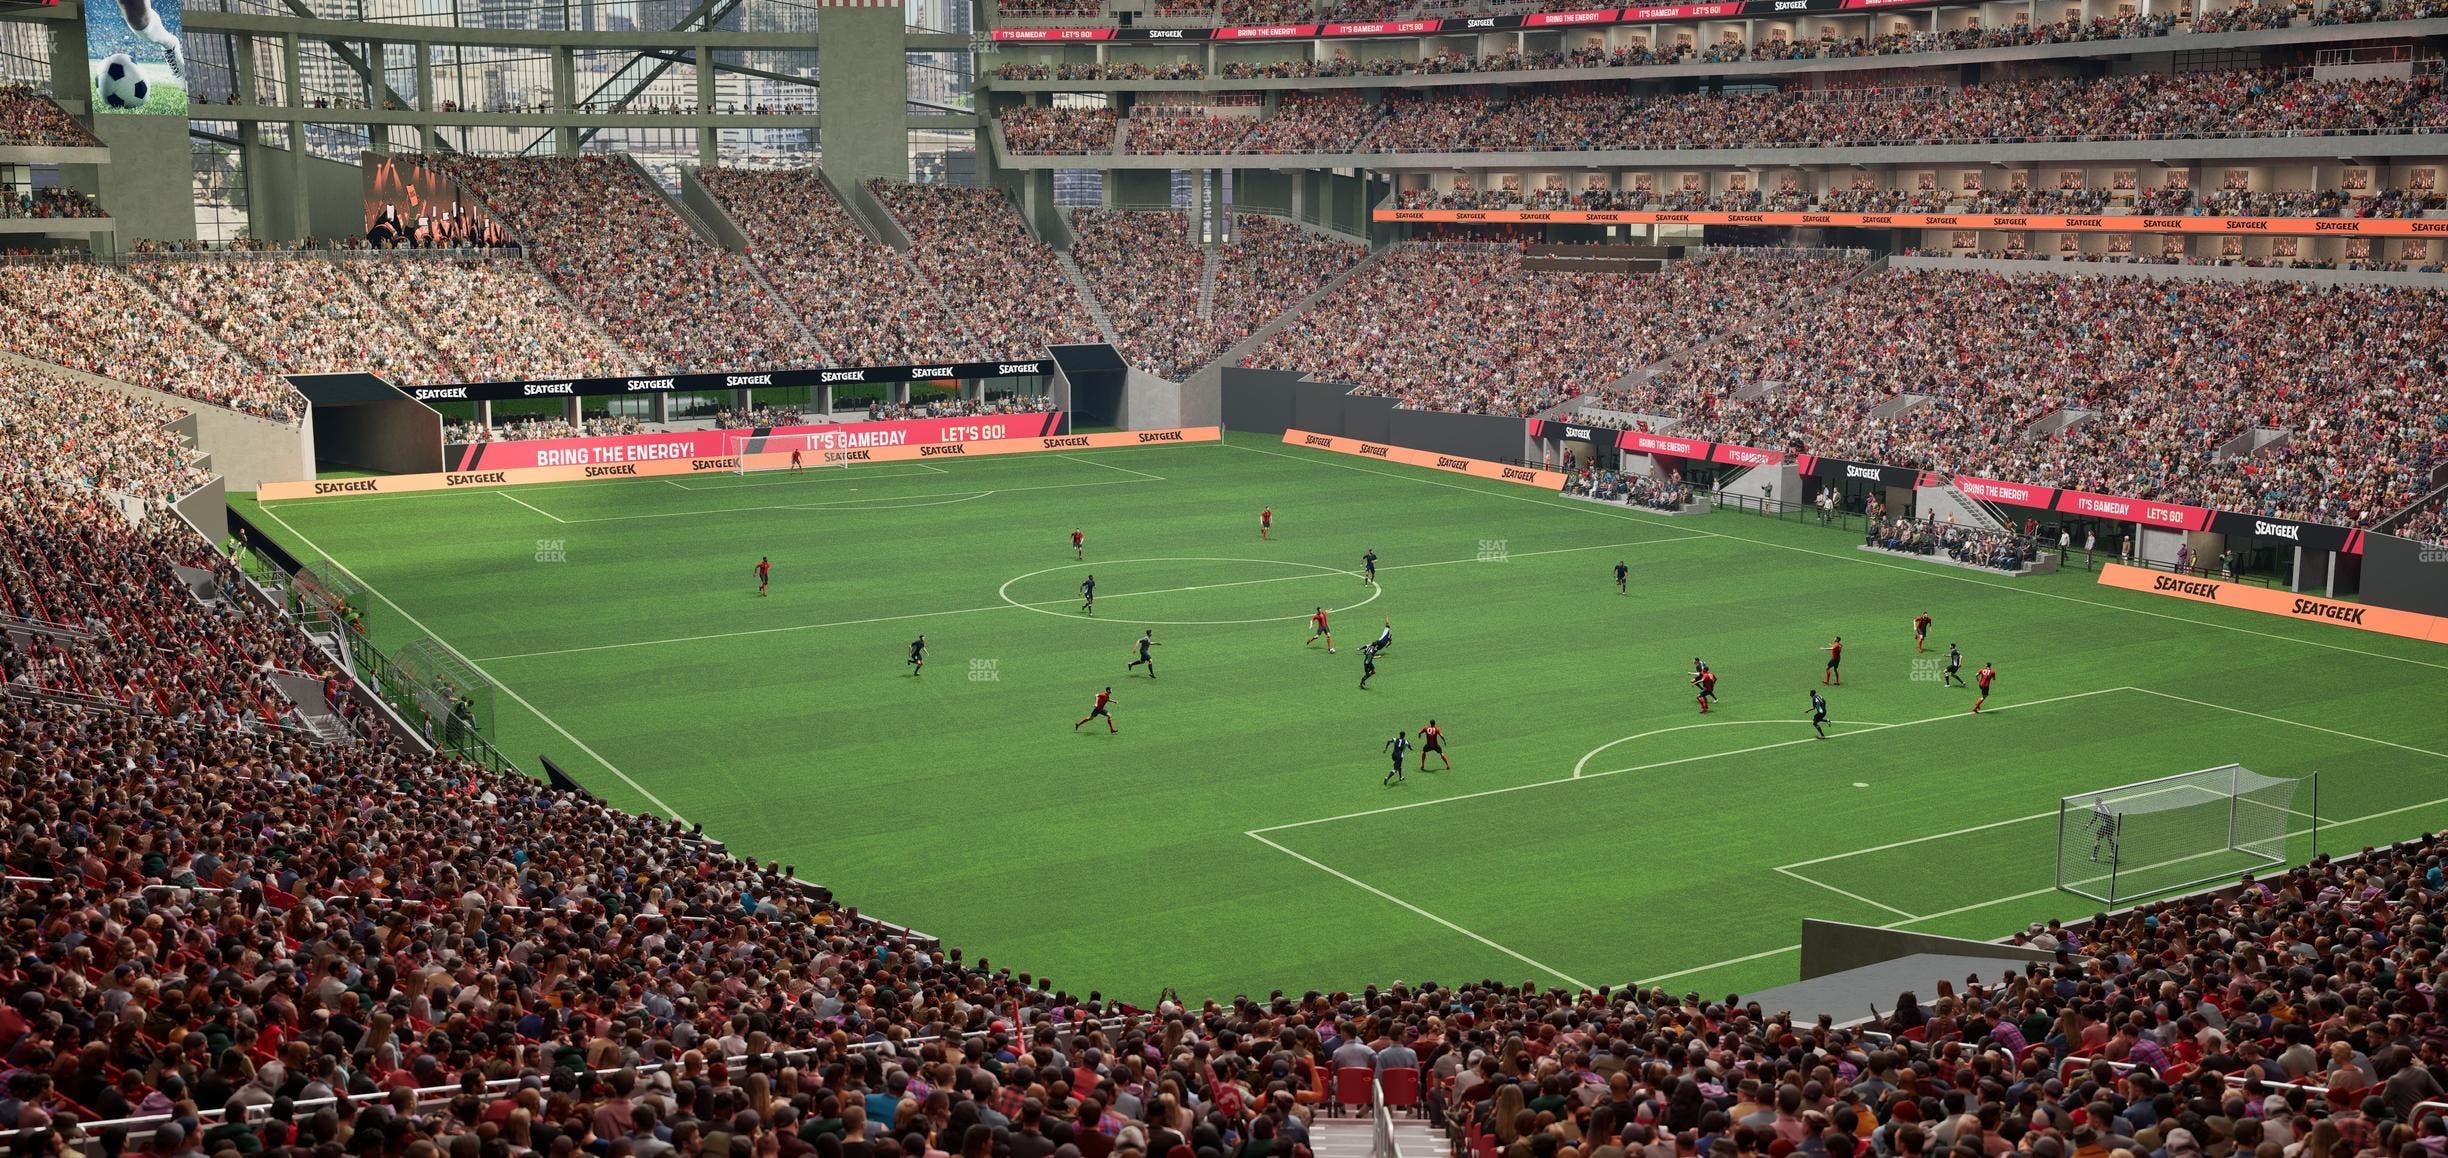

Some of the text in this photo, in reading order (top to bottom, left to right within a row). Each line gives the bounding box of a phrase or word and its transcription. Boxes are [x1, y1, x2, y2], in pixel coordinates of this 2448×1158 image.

[1692, 6, 1721, 15] LET'S GO!
[1775, 1, 1807, 11] SEATGEEK
[1546, 13, 1599, 23] BRING THE ENERGY!
[1639, 8, 1680, 18] IT'S GAMEDAY
[1467, 18, 1494, 28] SEATGEEK
[1150, 30, 1183, 38] SEATGEEK
[1396, 212, 1424, 220] SEATGEEK
[1456, 212, 1486, 220] SEATGEEK
[1656, 214, 1689, 222] SEATGEEK
[1728, 214, 1763, 222] SEATGEEK
[1862, 216, 1892, 224] SEATGEEK
[1926, 216, 1957, 224] SEATGEEK
[1994, 218, 2027, 226] SEATGEEK
[2066, 218, 2101, 226] SEATGEEK
[2144, 220, 2182, 228] SEATGEEK
[2226, 220, 2268, 230] SEATGEEK
[2316, 222, 2360, 231] SEATGEEK
[912, 366, 953, 378] SEATGEEK
[999, 363, 1039, 374] SEATGEEK
[726, 374, 772, 386] SEATGEEK
[821, 370, 864, 382] SEATGEEK
[524, 382, 574, 396] SEATGEEK
[628, 378, 675, 391] SEATGEEK
[416, 387, 467, 400] SEATGEEK
[941, 425, 1006, 442] LET'S GO!
[1139, 431, 1183, 442] SEATGEEK
[1566, 426, 1591, 440] SEATGEEK
[806, 430, 907, 450] IT'S GAMEDAY
[1044, 436, 1090, 448] SEATGEEK
[1305, 434, 1333, 448] SEATGEEK
[1656, 440, 1666, 450] THE
[537, 442, 694, 466] BRING THE ENERGY!
[920, 444, 966, 456] SEATGEEK
[1359, 444, 1388, 458] SEATGEEK
[1729, 450, 1740, 460] IT'S
[824, 450, 870, 463] SEATGEEK
[692, 457, 741, 471] SEATGEEK
[1436, 457, 1469, 472] SEATGEEK
[585, 464, 636, 478] SEATGEEK
[1502, 467, 1538, 482] SEATGEEK
[1846, 465, 1880, 482] SEATGEEK
[447, 472, 506, 486] SEATGEEK
[314, 480, 378, 494] SEATGEEK
[1986, 485, 1998, 496] THE
[2000, 487, 2028, 501] ENERGY!
[2078, 498, 2129, 516] IT'S GAMEDAY
[2147, 506, 2184, 524] LET'S GO!
[2255, 520, 2299, 541] SEATGEEK
[2154, 576, 2220, 600] SEATGEEK
[2292, 599, 2367, 625] SEATGEEK
